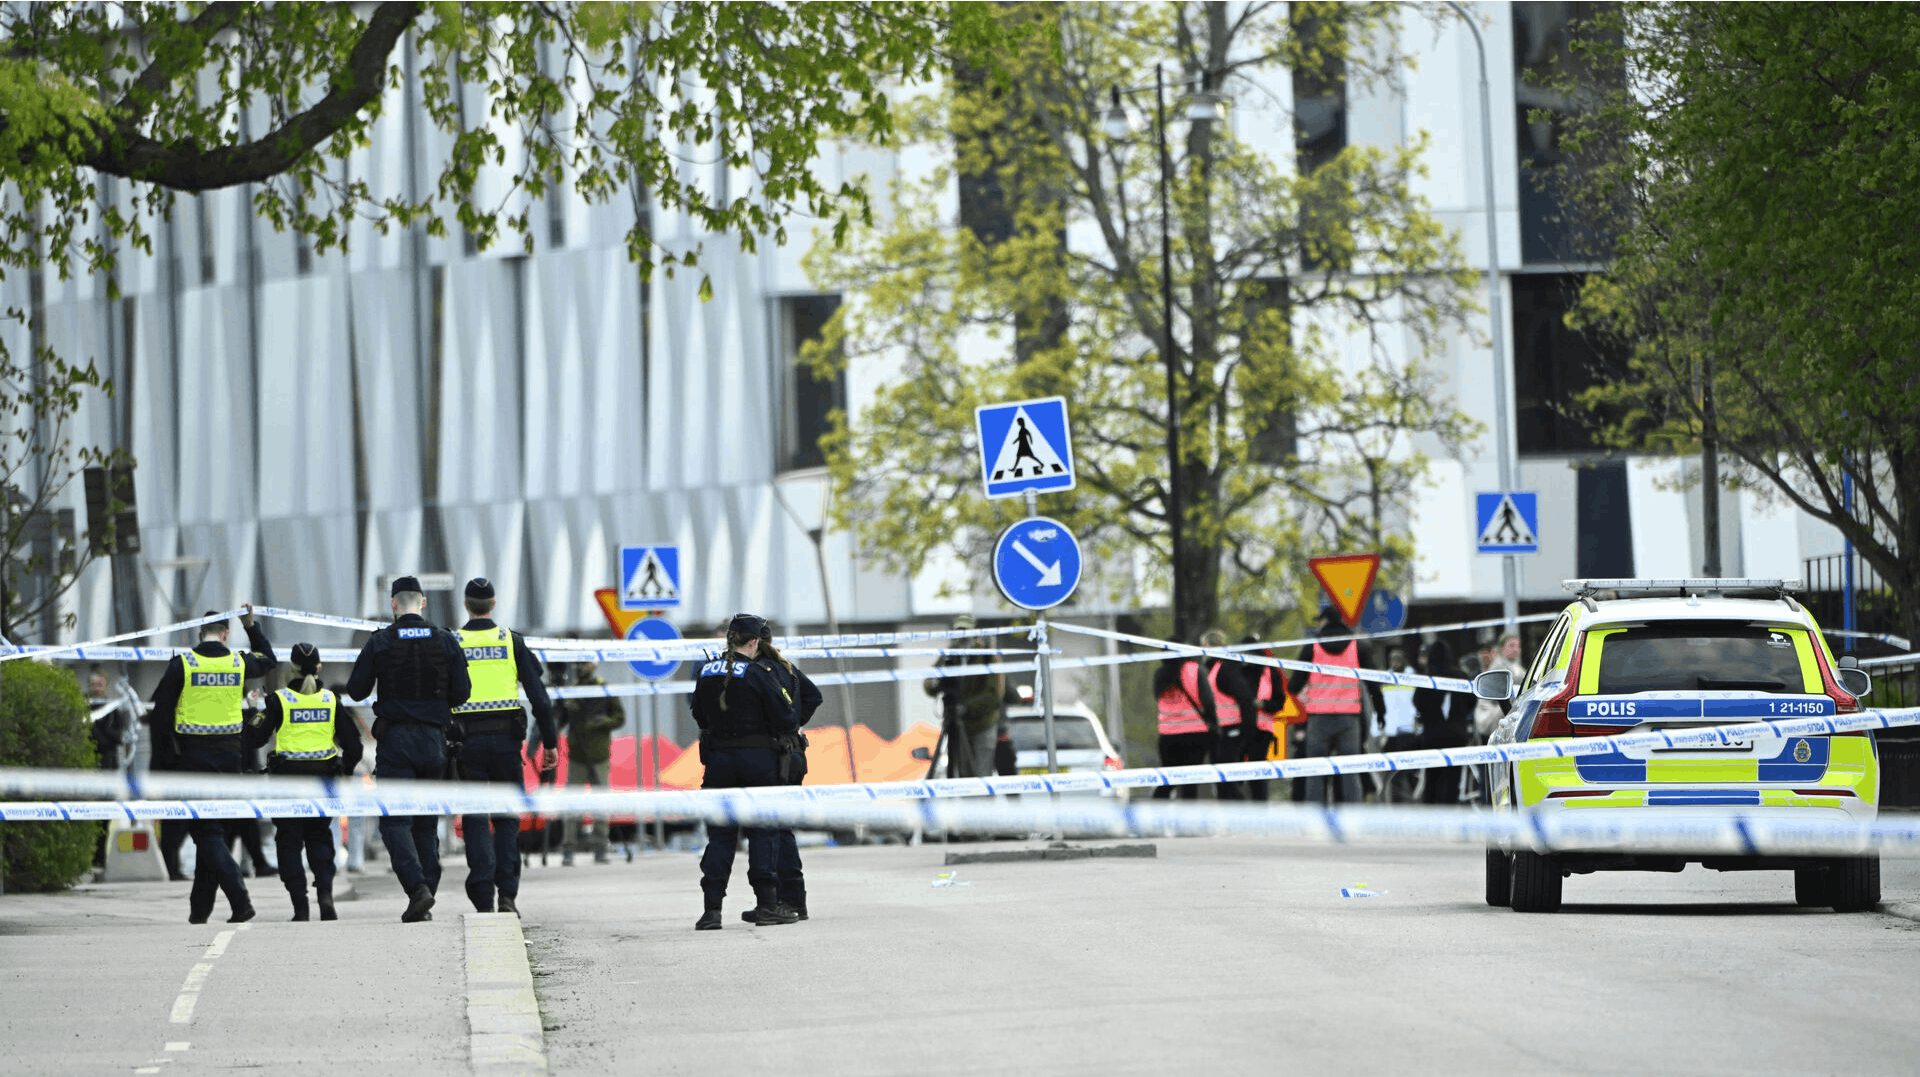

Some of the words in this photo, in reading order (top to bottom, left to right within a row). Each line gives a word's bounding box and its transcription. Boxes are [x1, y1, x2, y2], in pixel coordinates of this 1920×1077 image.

[400, 628, 432, 638] POLIS
[463, 647, 503, 660] POLIS
[197, 673, 236, 686] POLIS
[1587, 702, 1637, 716] POLIS
[1769, 702, 1776, 713] 1
[1779, 702, 1824, 714] 21-1150
[293, 710, 328, 721] POLIS
